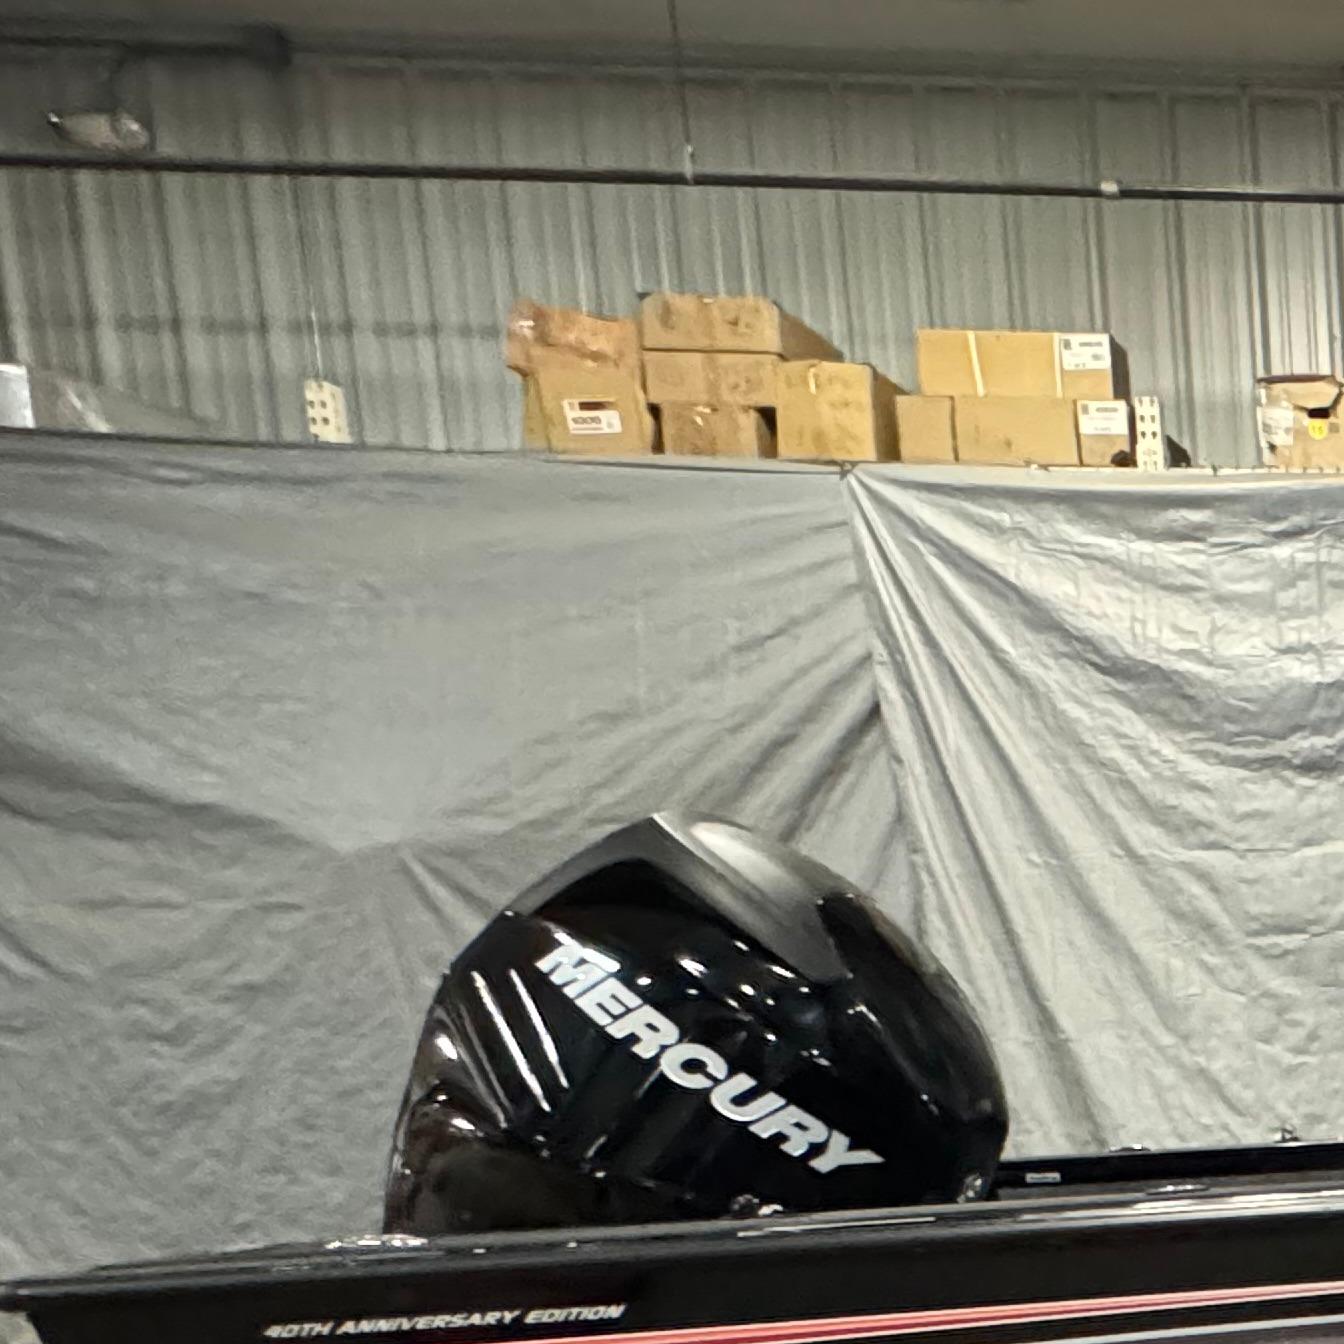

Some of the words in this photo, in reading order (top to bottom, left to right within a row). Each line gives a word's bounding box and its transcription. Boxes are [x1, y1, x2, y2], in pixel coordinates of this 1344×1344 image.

[534, 943, 886, 1174] MERCURY
[264, 1320, 334, 1338] 40TH
[335, 1308, 521, 1336] ANNIVERSARY
[524, 1303, 626, 1324] EDITION
